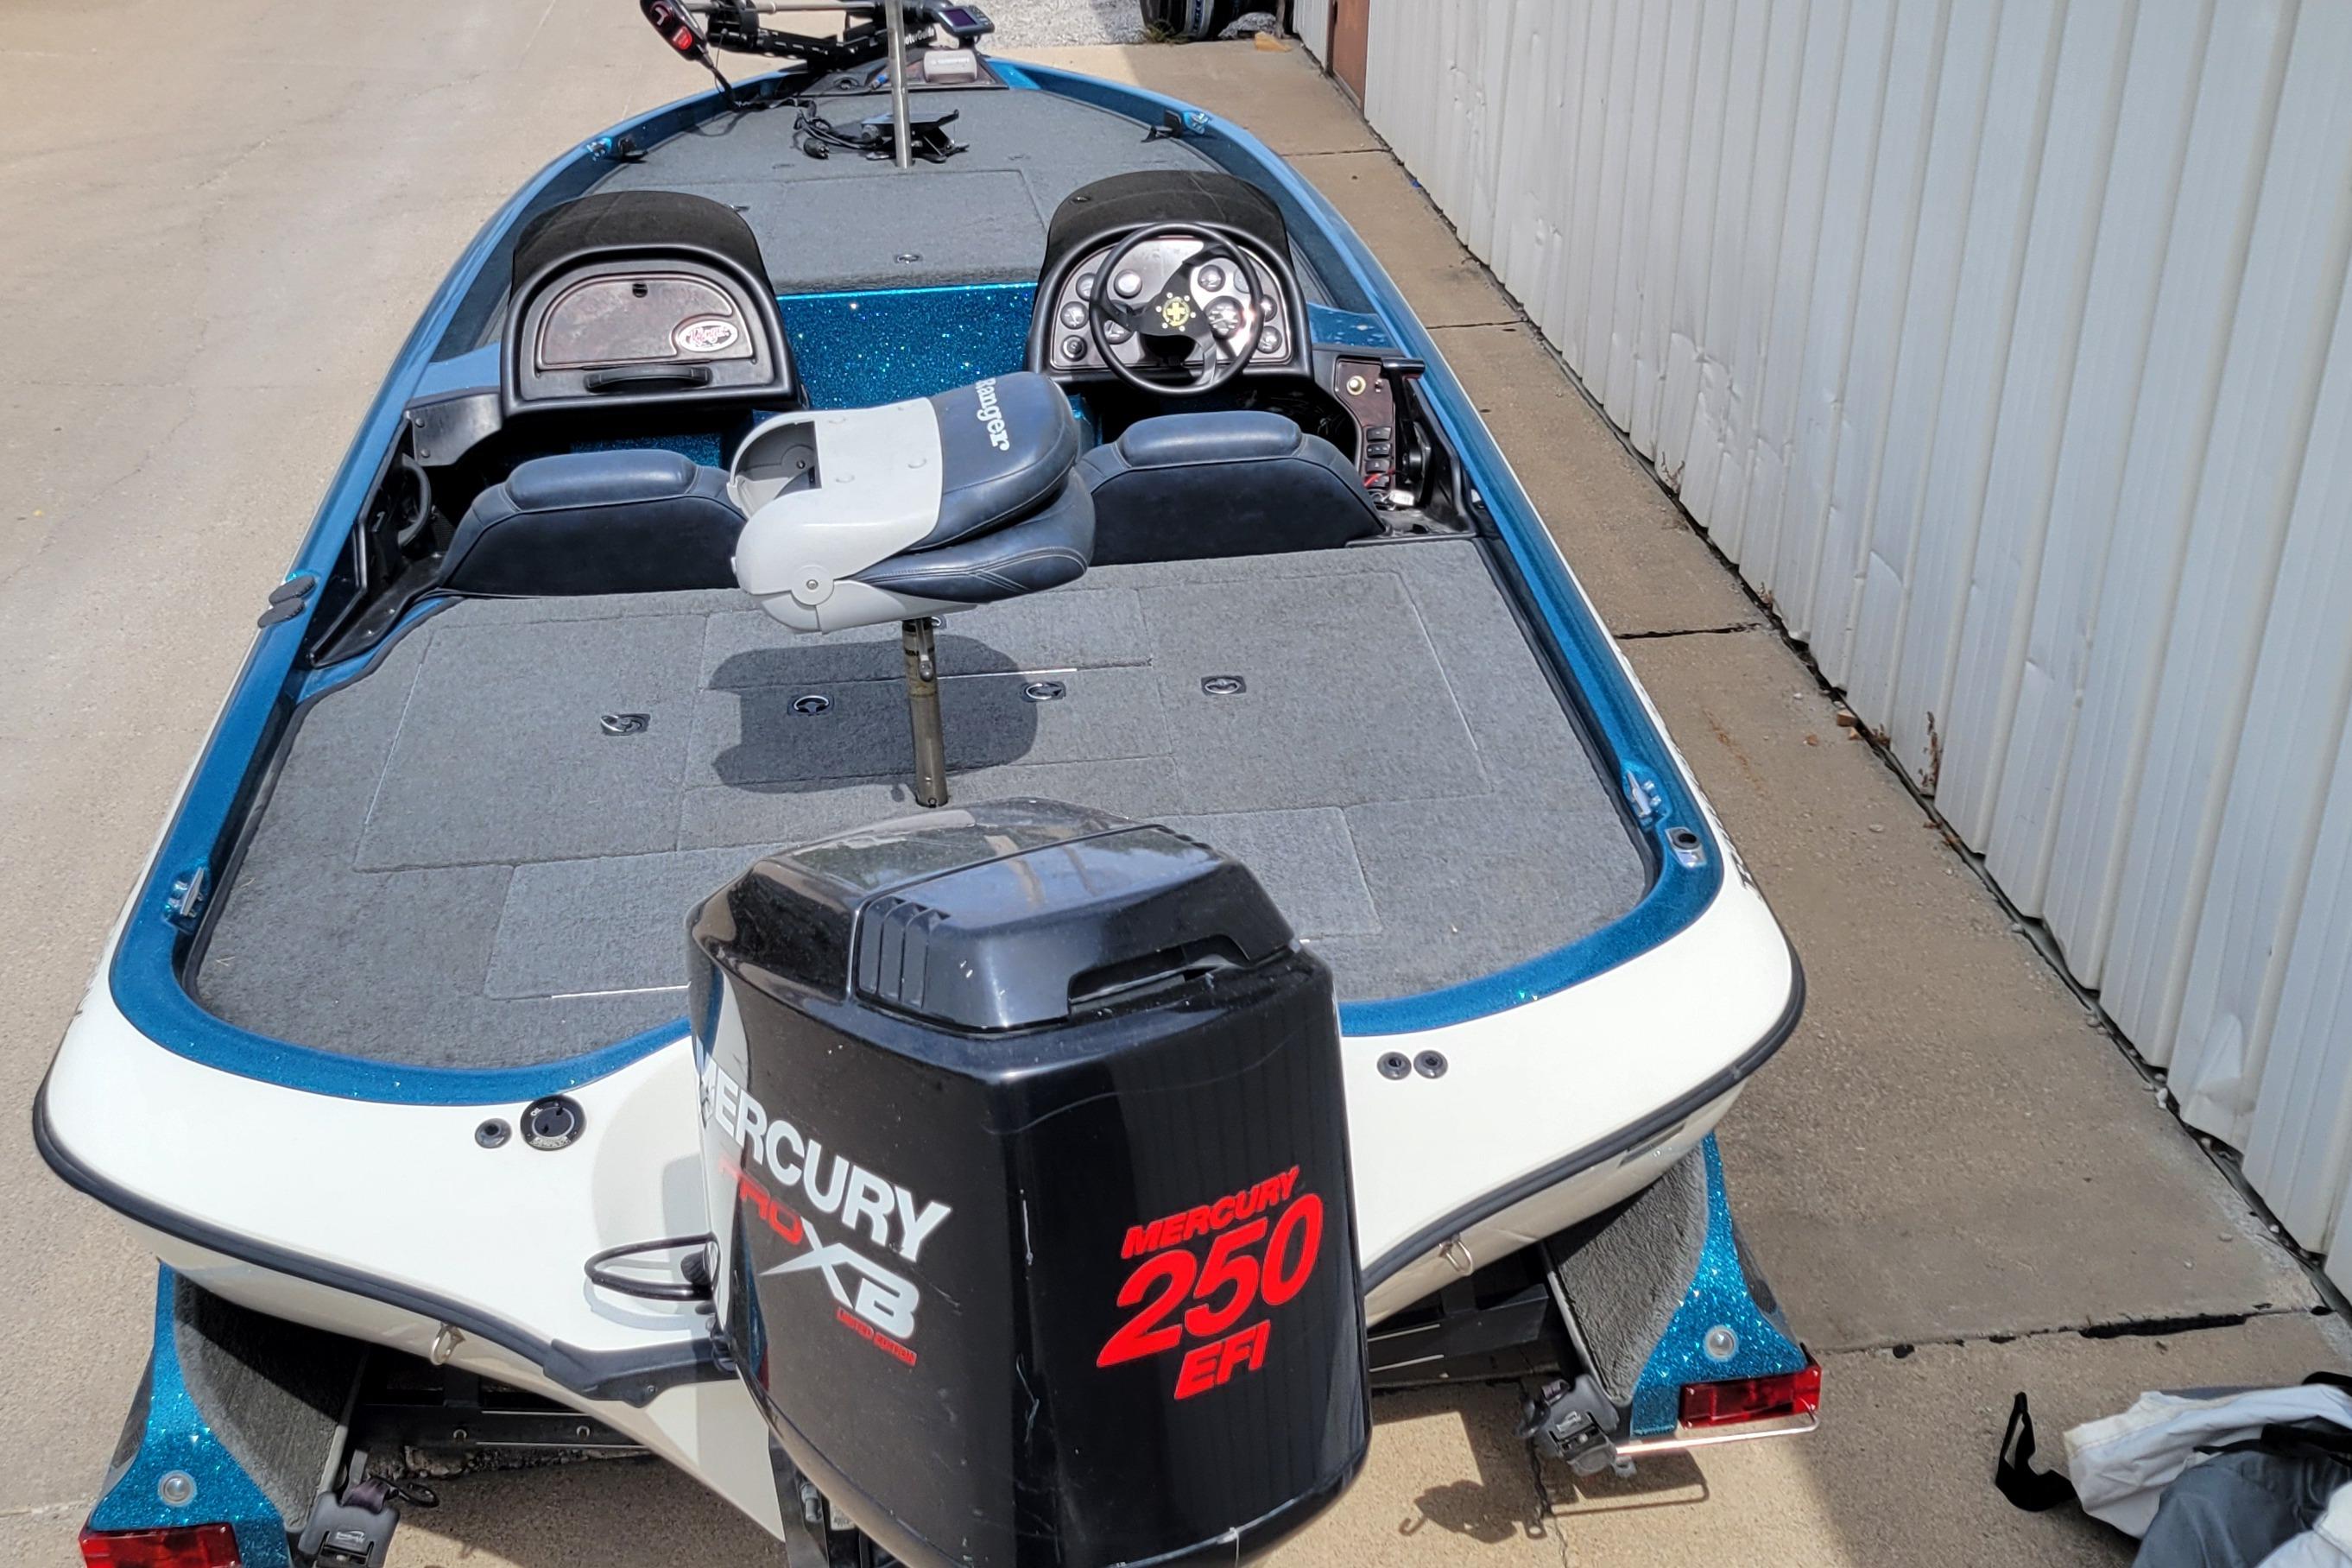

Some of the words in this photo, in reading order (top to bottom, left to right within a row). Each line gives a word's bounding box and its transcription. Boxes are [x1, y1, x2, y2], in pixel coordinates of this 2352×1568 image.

[905, 26, 935, 45] otorGuide
[975, 377, 1010, 451] Ranger
[1120, 1164, 1300, 1260] MERCURY
[1095, 1192, 1324, 1369] 250
[1173, 1319, 1271, 1400] EFI
